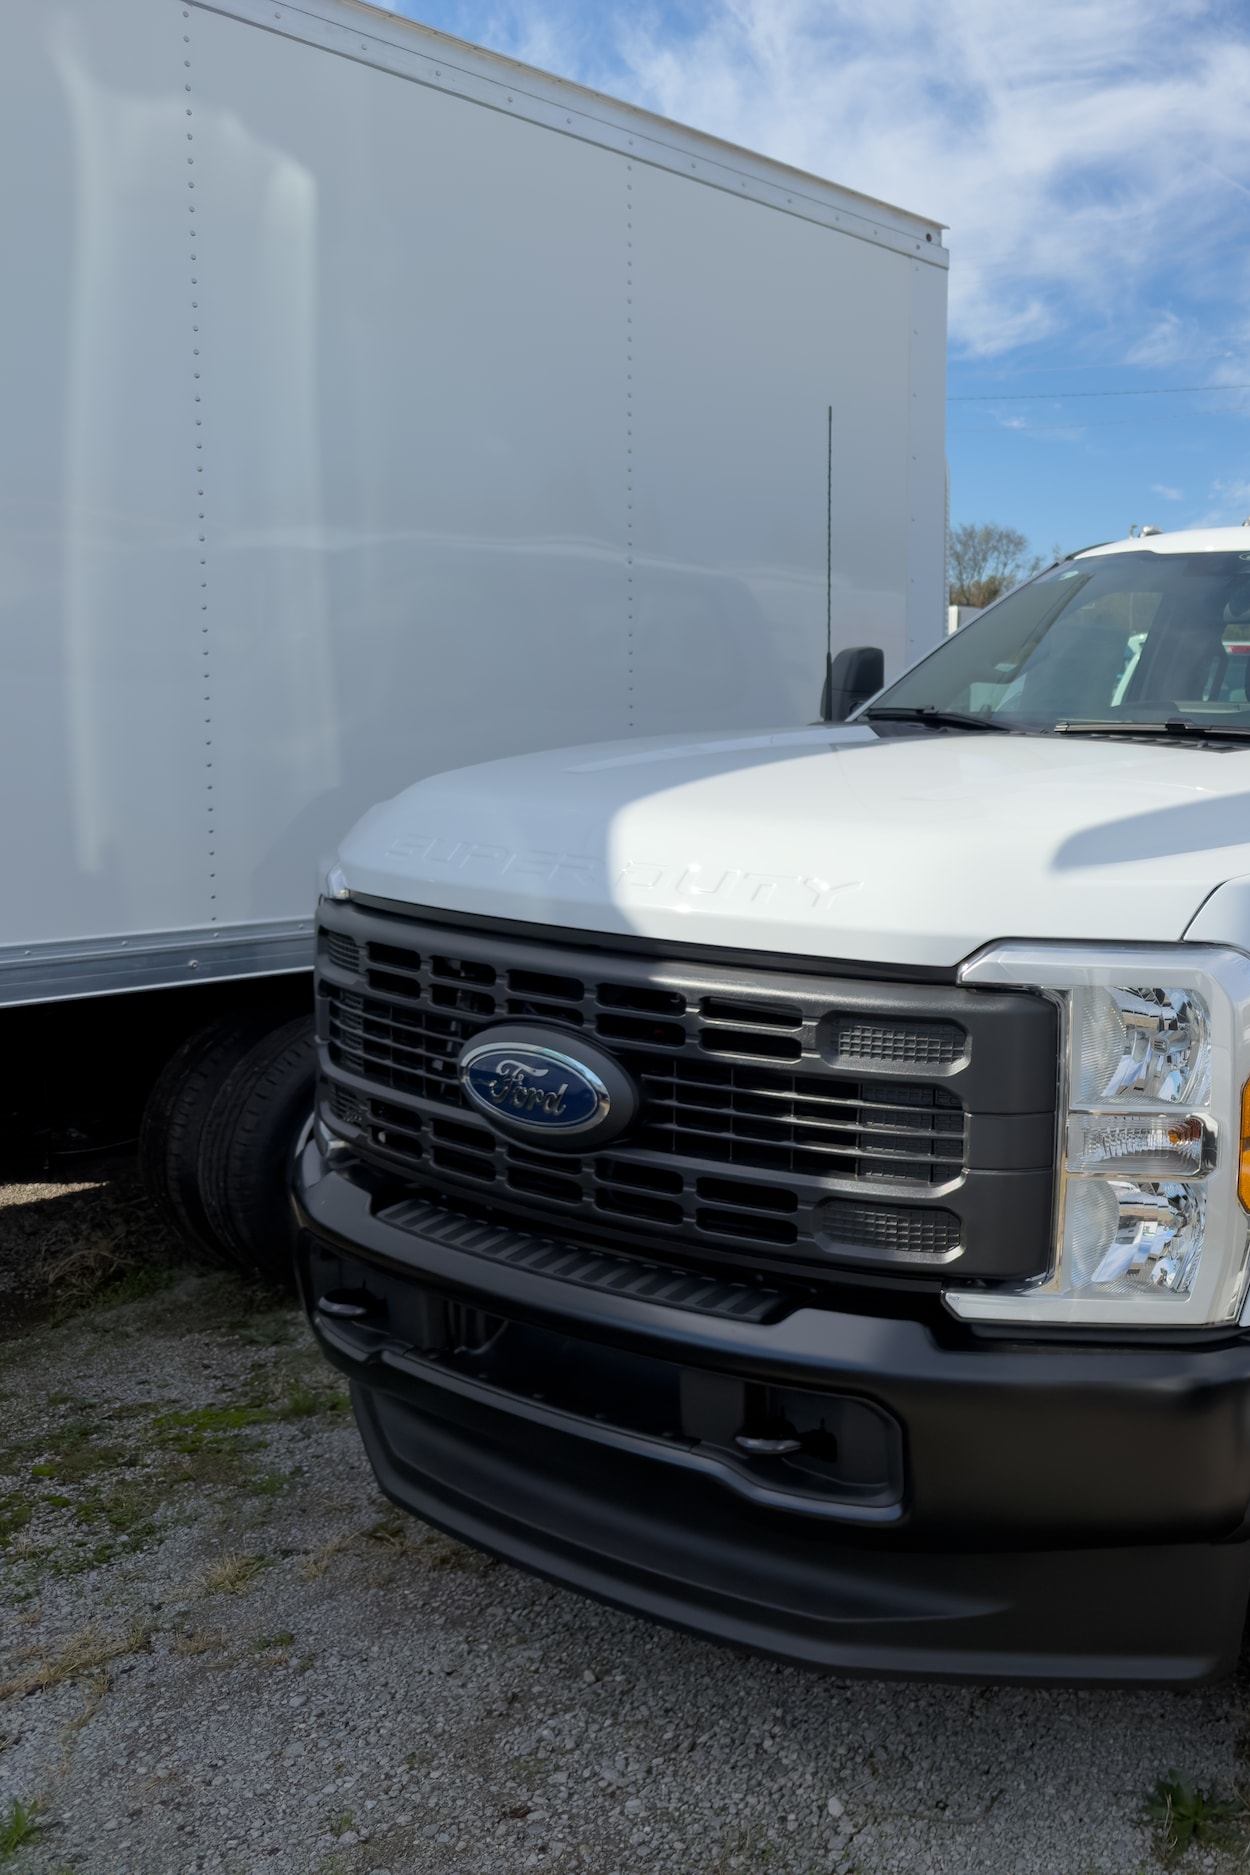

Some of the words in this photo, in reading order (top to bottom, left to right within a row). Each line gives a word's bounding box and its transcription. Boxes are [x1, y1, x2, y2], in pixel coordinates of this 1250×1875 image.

[385, 832, 606, 886] SUPER
[618, 857, 866, 910] DUTY
[488, 1058, 570, 1117] Ford
